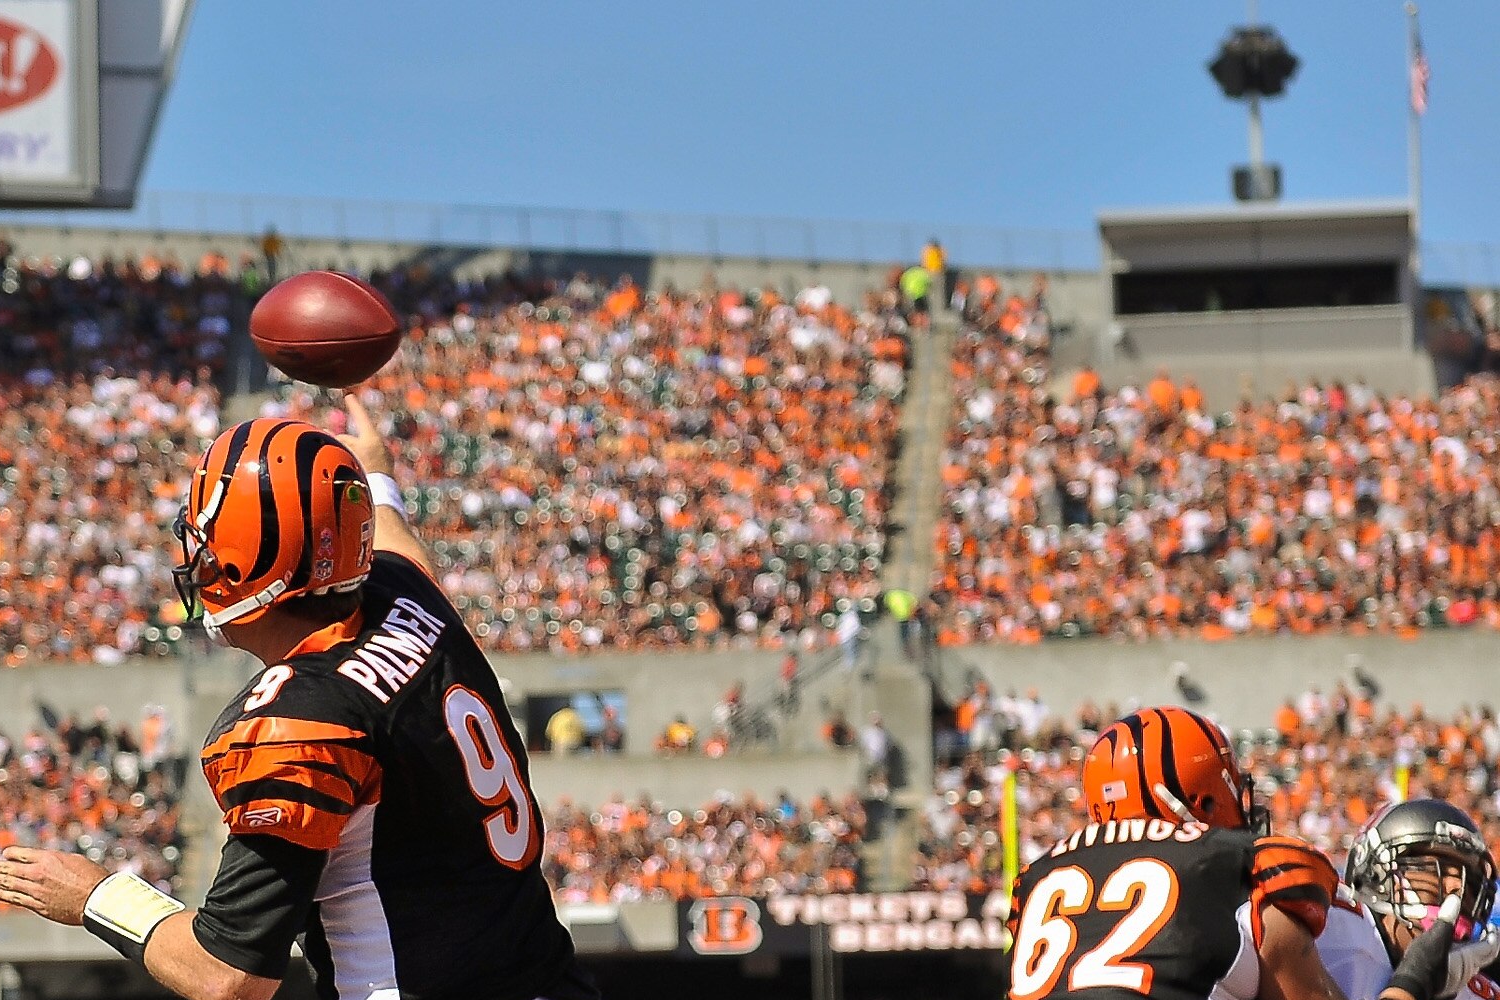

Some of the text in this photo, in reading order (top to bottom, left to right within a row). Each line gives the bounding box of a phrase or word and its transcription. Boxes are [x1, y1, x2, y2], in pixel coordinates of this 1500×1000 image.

[244, 664, 295, 713] 9
[337, 597, 446, 703] PALMER
[444, 684, 540, 870] 9
[829, 917, 1006, 952] BENGAL
